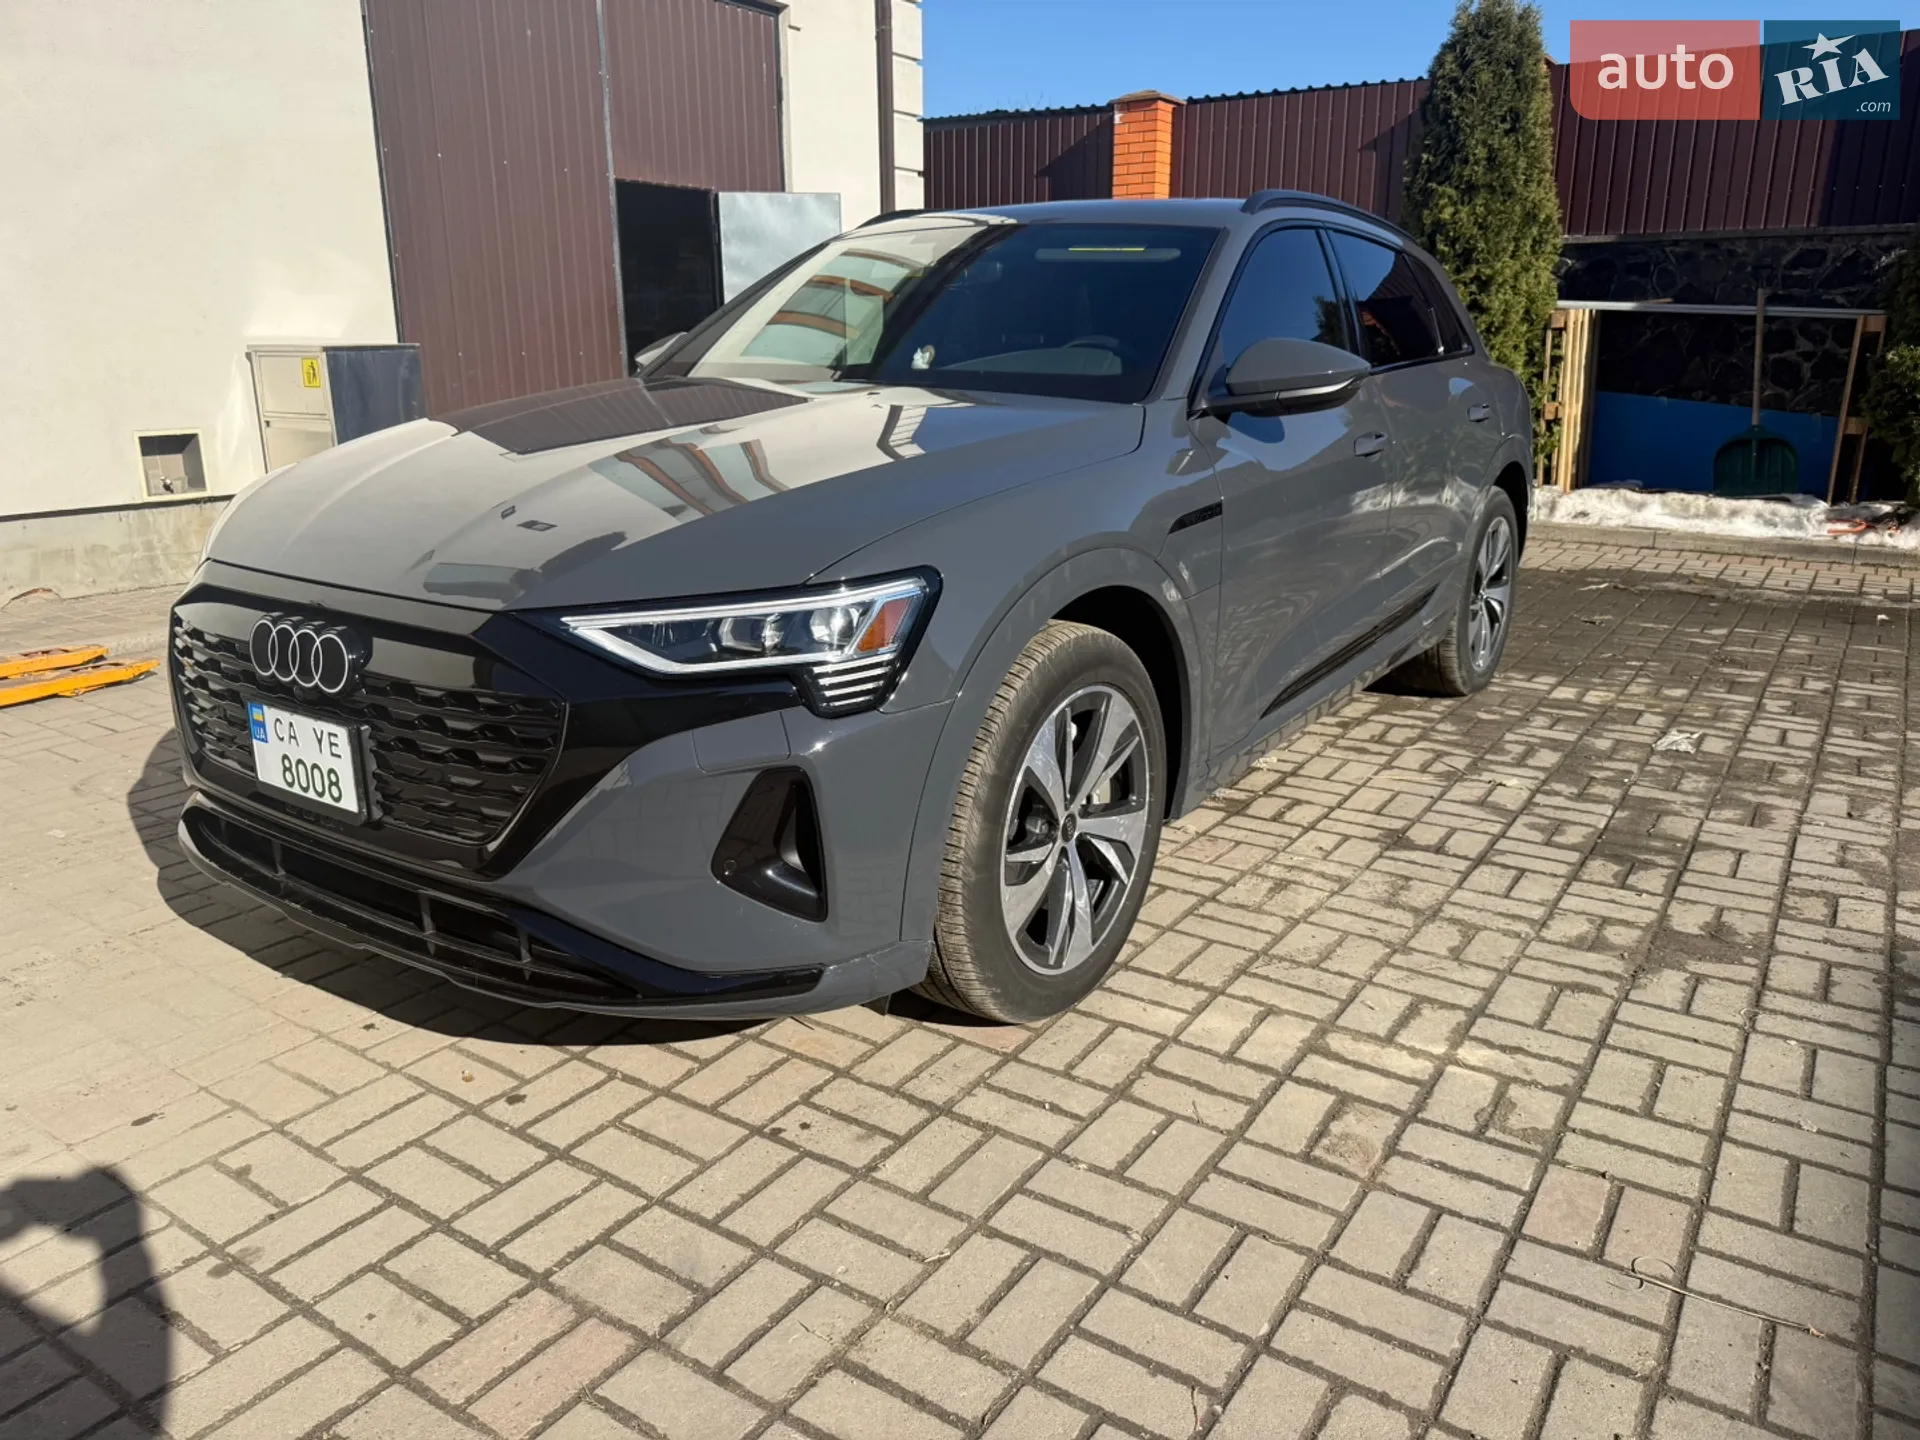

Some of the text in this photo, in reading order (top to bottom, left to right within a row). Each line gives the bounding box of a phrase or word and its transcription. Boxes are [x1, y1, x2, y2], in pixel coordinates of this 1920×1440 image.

[274, 717, 342, 759] CA YE
[281, 753, 343, 803] 8008
